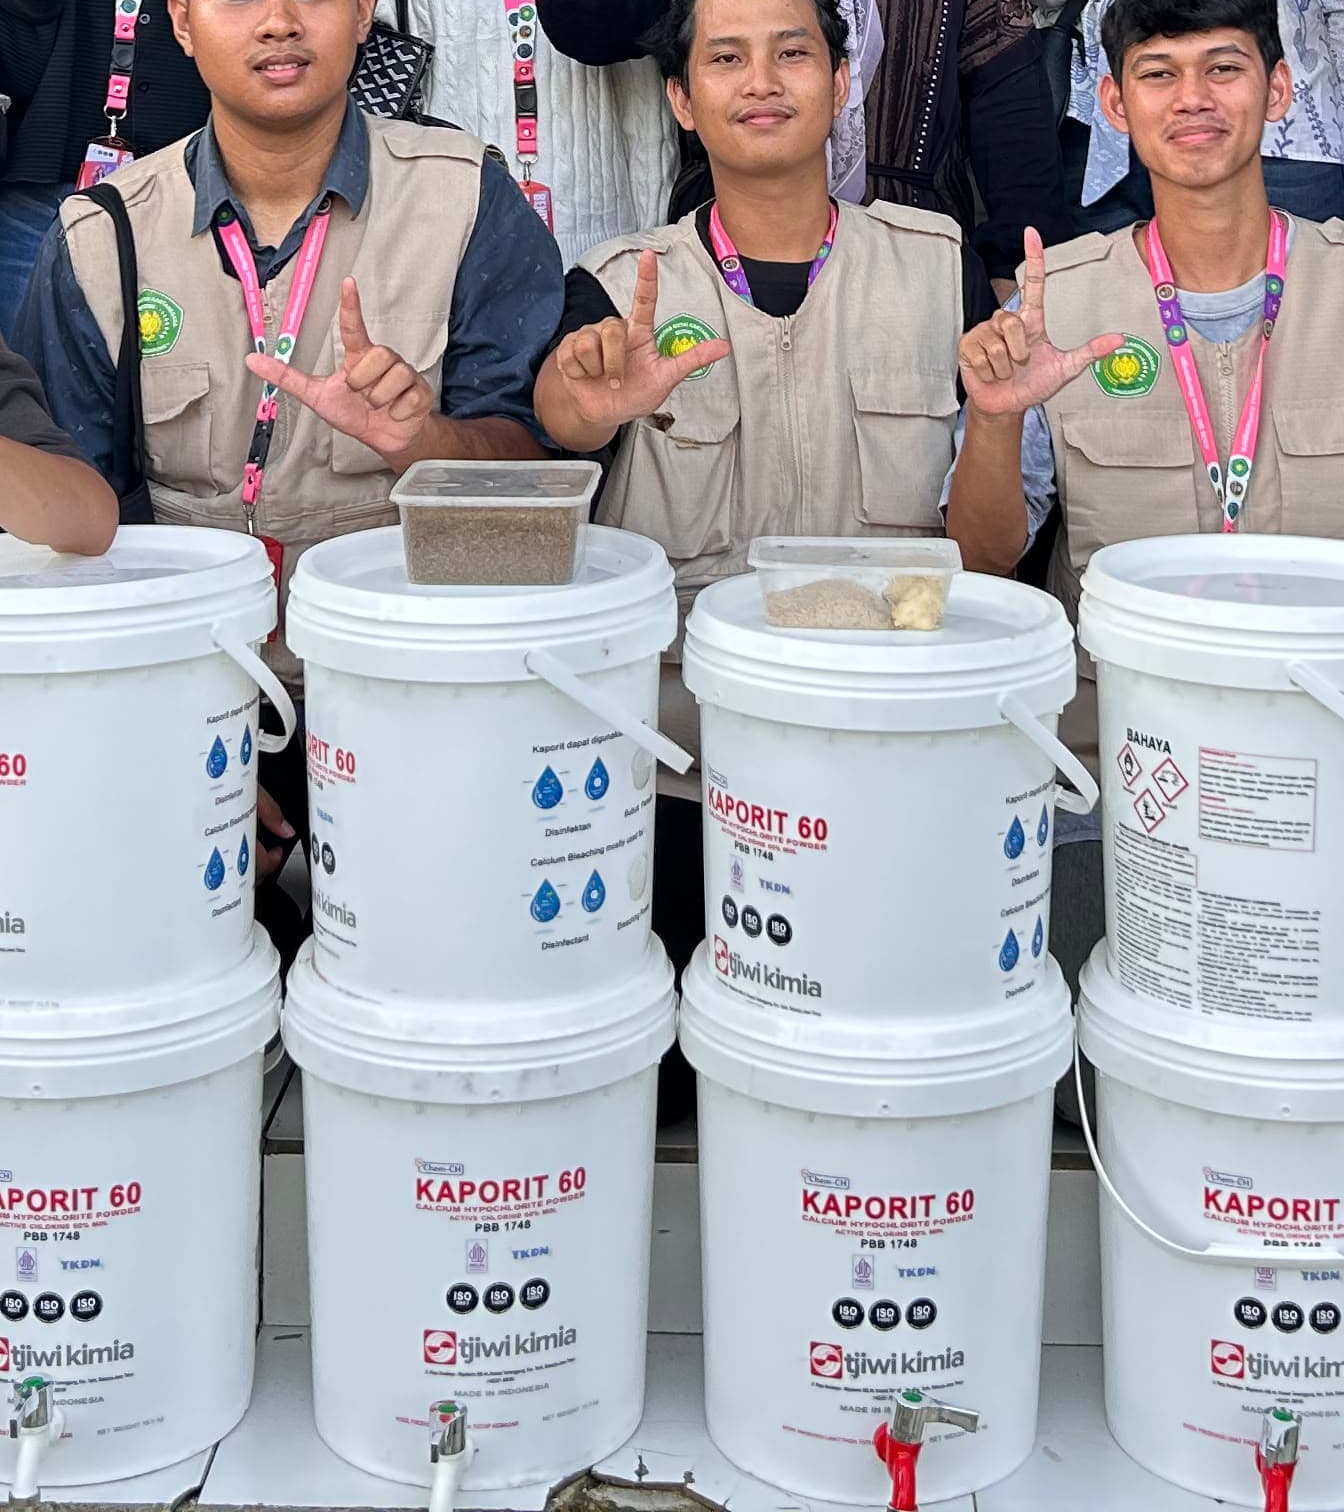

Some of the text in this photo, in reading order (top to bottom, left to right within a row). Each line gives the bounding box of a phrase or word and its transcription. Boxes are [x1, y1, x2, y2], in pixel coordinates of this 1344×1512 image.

[1126, 727, 1172, 754] BAHAYA
[532, 742, 565, 755] Kaporit
[335, 748, 356, 773] 60
[708, 786, 828, 841] KAPORIT 60
[754, 847, 774, 861] 1748
[530, 855, 566, 867] Calcium
[323, 896, 357, 929] kimia
[728, 948, 761, 982] tjiwi
[764, 965, 822, 998] kimia
[416, 1166, 586, 1204] KAPORIT 60
[110, 1181, 142, 1208] 60
[416, 1191, 585, 1213] CALCIUM HYPOCHLORITE POWDER
[802, 1188, 974, 1220] KAPORIT 60
[1203, 1186, 1340, 1222] KAPORIT
[96, 1206, 141, 1219] POWDER
[475, 1220, 531, 1233] PBB 1748
[802, 1213, 974, 1229] CALCIUM HYPOCHLORITE POWDER
[1203, 1211, 1249, 1227] CALCIUM
[1252, 1220, 1334, 1232] HYPOCHLORITE
[23, 1231, 80, 1241] PBB 1748
[861, 1239, 918, 1249] PBB 1748
[512, 1246, 549, 1260] TKDN
[60, 1258, 100, 1270] TKDN
[898, 1266, 936, 1278] TKDN
[1301, 1270, 1340, 1282] TKDN
[453, 1291, 472, 1301] ISO
[491, 1290, 509, 1300] ISO
[527, 1285, 544, 1295] ISO
[6, 1297, 23, 1308] ISO
[40, 1300, 59, 1310] ISO
[77, 1298, 96, 1308] ISO
[839, 1305, 857, 1316] ISO
[876, 1308, 895, 1317] ISO
[913, 1305, 930, 1315] ISO
[1241, 1305, 1260, 1317] ISO
[1279, 1309, 1298, 1320] ISO
[1316, 1310, 1335, 1320] ISO
[459, 1325, 577, 1364] tjiwi kimia
[11, 1338, 135, 1372] tjiwi kimia
[844, 1346, 965, 1379] tjiwi kimia
[1245, 1352, 1300, 1379] tjiwi
